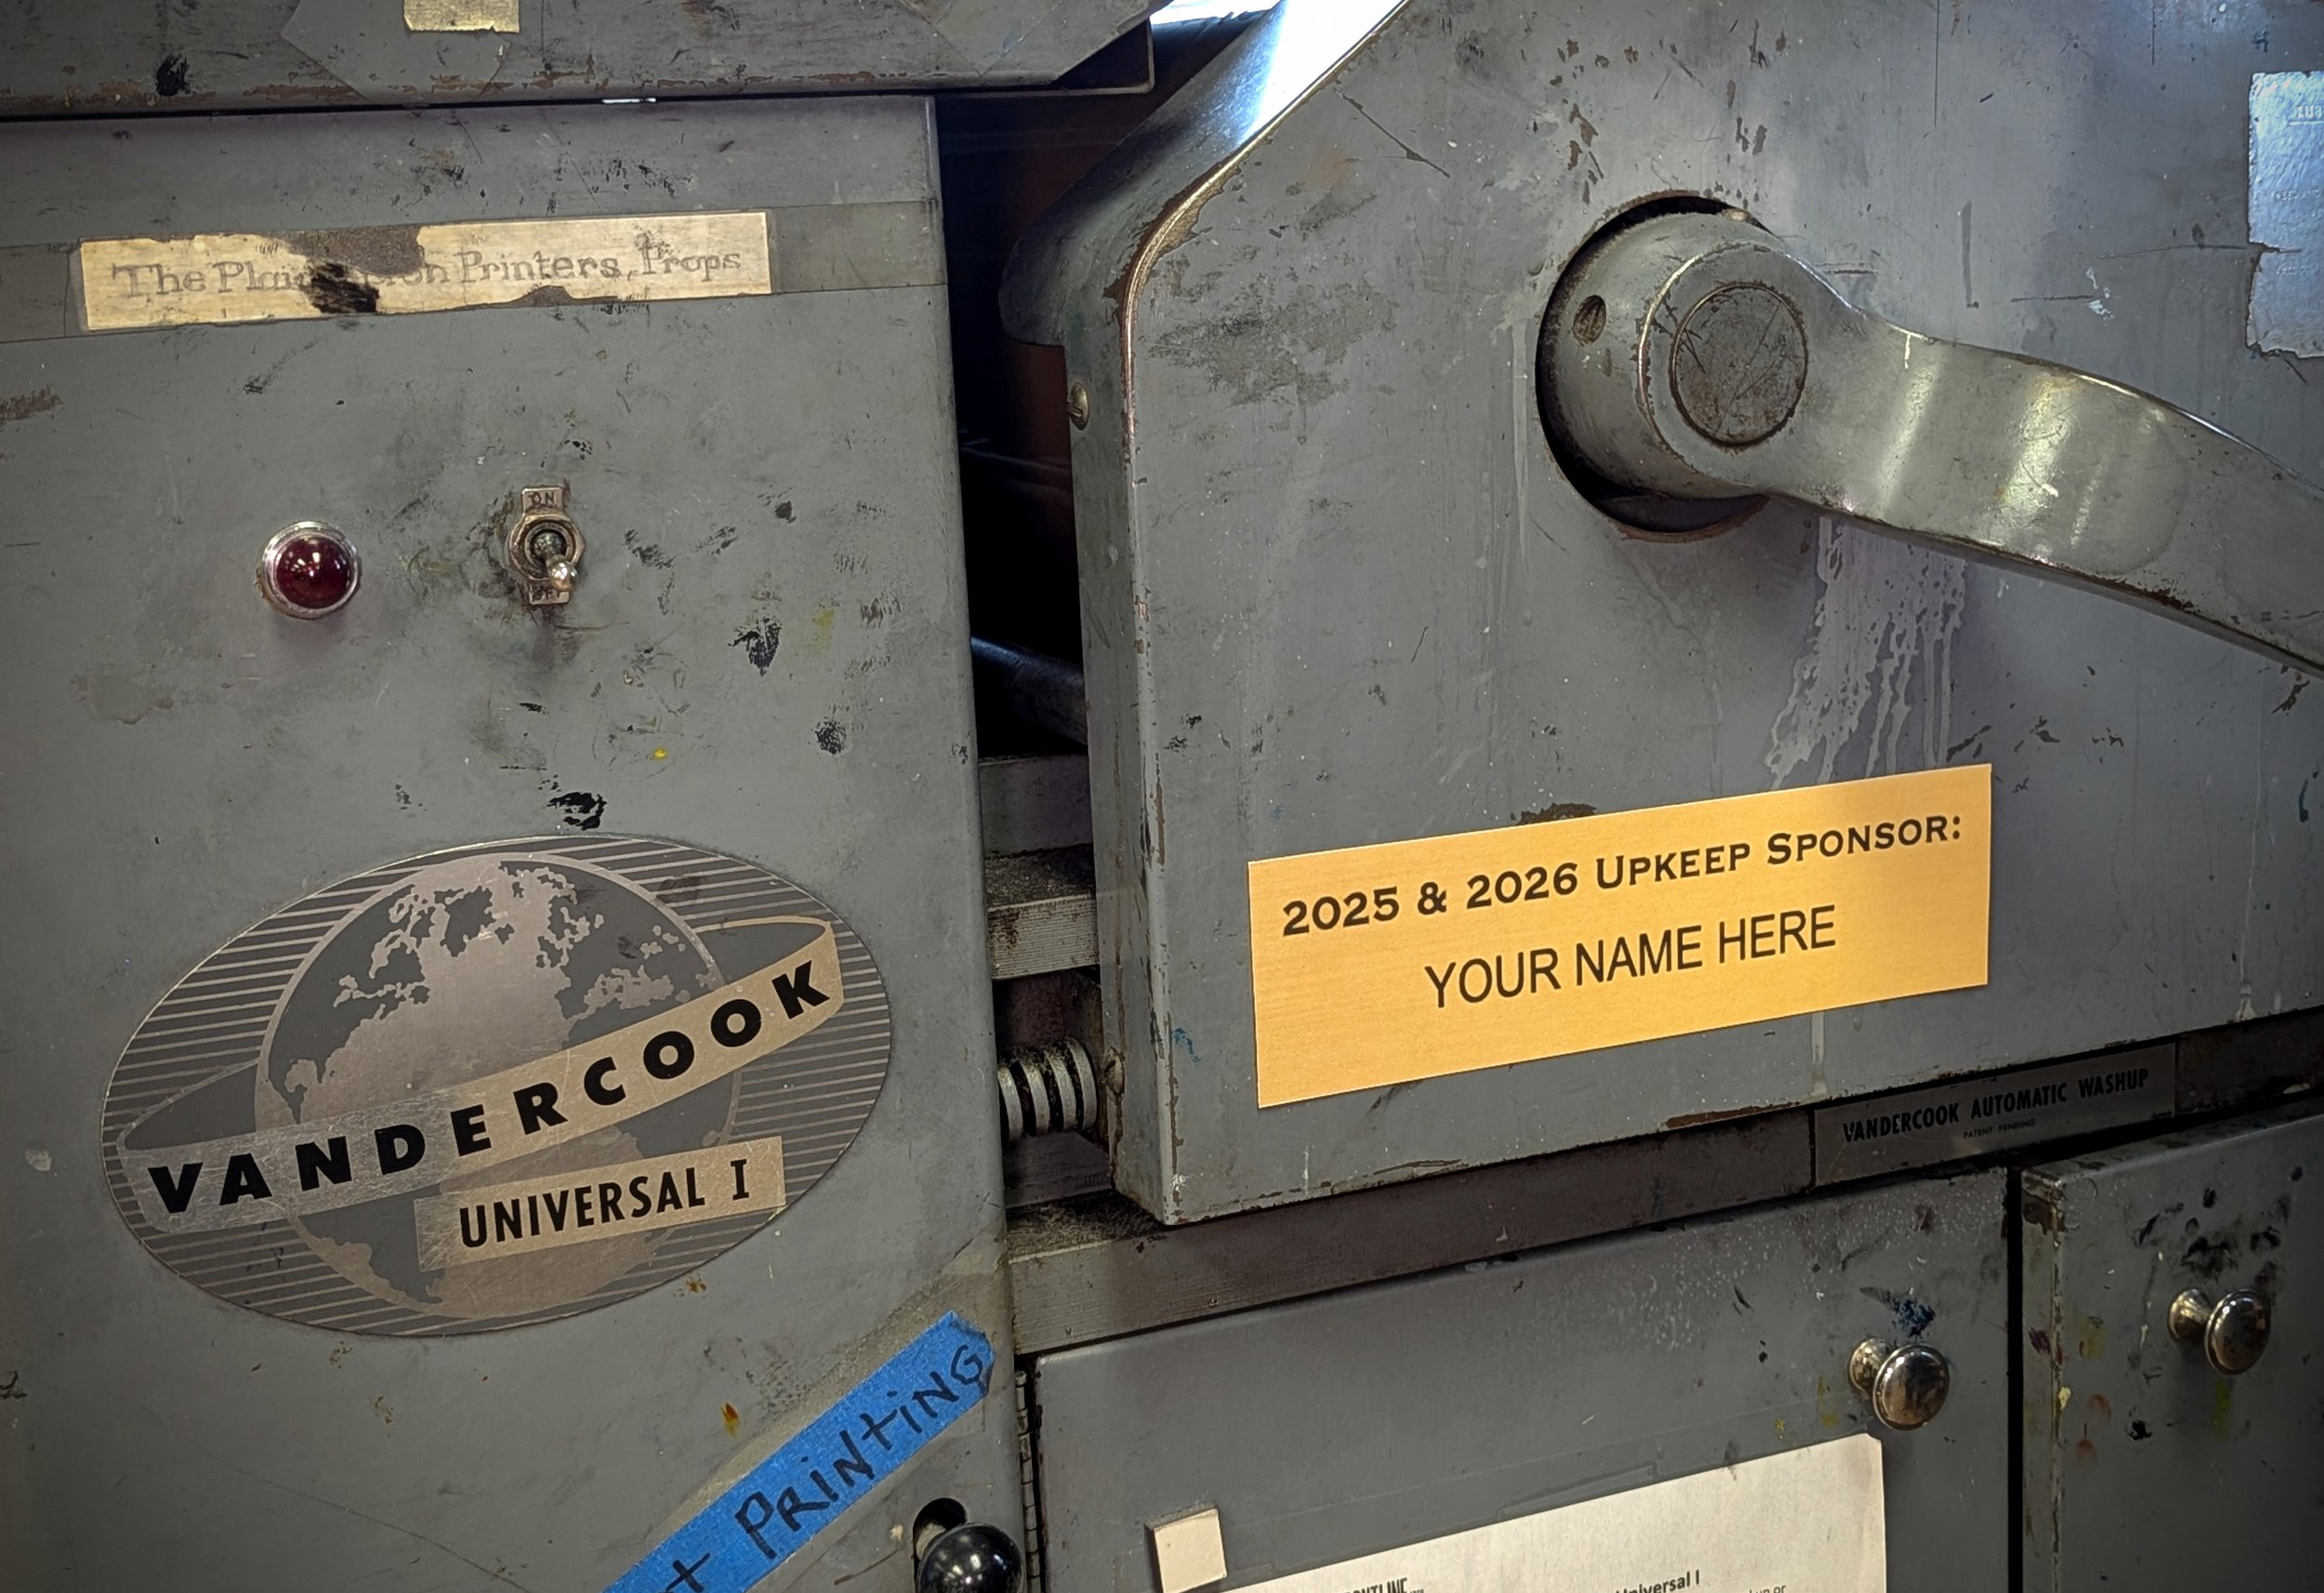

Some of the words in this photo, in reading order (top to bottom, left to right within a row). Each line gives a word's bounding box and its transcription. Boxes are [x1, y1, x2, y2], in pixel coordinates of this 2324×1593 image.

[112, 262, 206, 298] The
[527, 491, 556, 506] ON
[1283, 886, 1400, 936] 2025
[1418, 881, 1448, 916] &
[1467, 862, 1578, 910] 2026
[1425, 948, 1561, 1008] YOUR
[1577, 925, 1703, 986] NAME
[1719, 904, 1837, 964] HERE
[148, 961, 830, 1214] VANDERCOOK
[1842, 1103, 1960, 1143] VANDERCOOK
[1971, 1082, 2067, 1120] AUTOMATIC
[2079, 1067, 2149, 1099] WASHUP
[1963, 1126, 1993, 1139] PATENT
[1999, 1118, 2036, 1131] PENDING
[459, 1166, 706, 1248] UNIVERSAL
[1616, 1571, 1691, 1593] iversal
